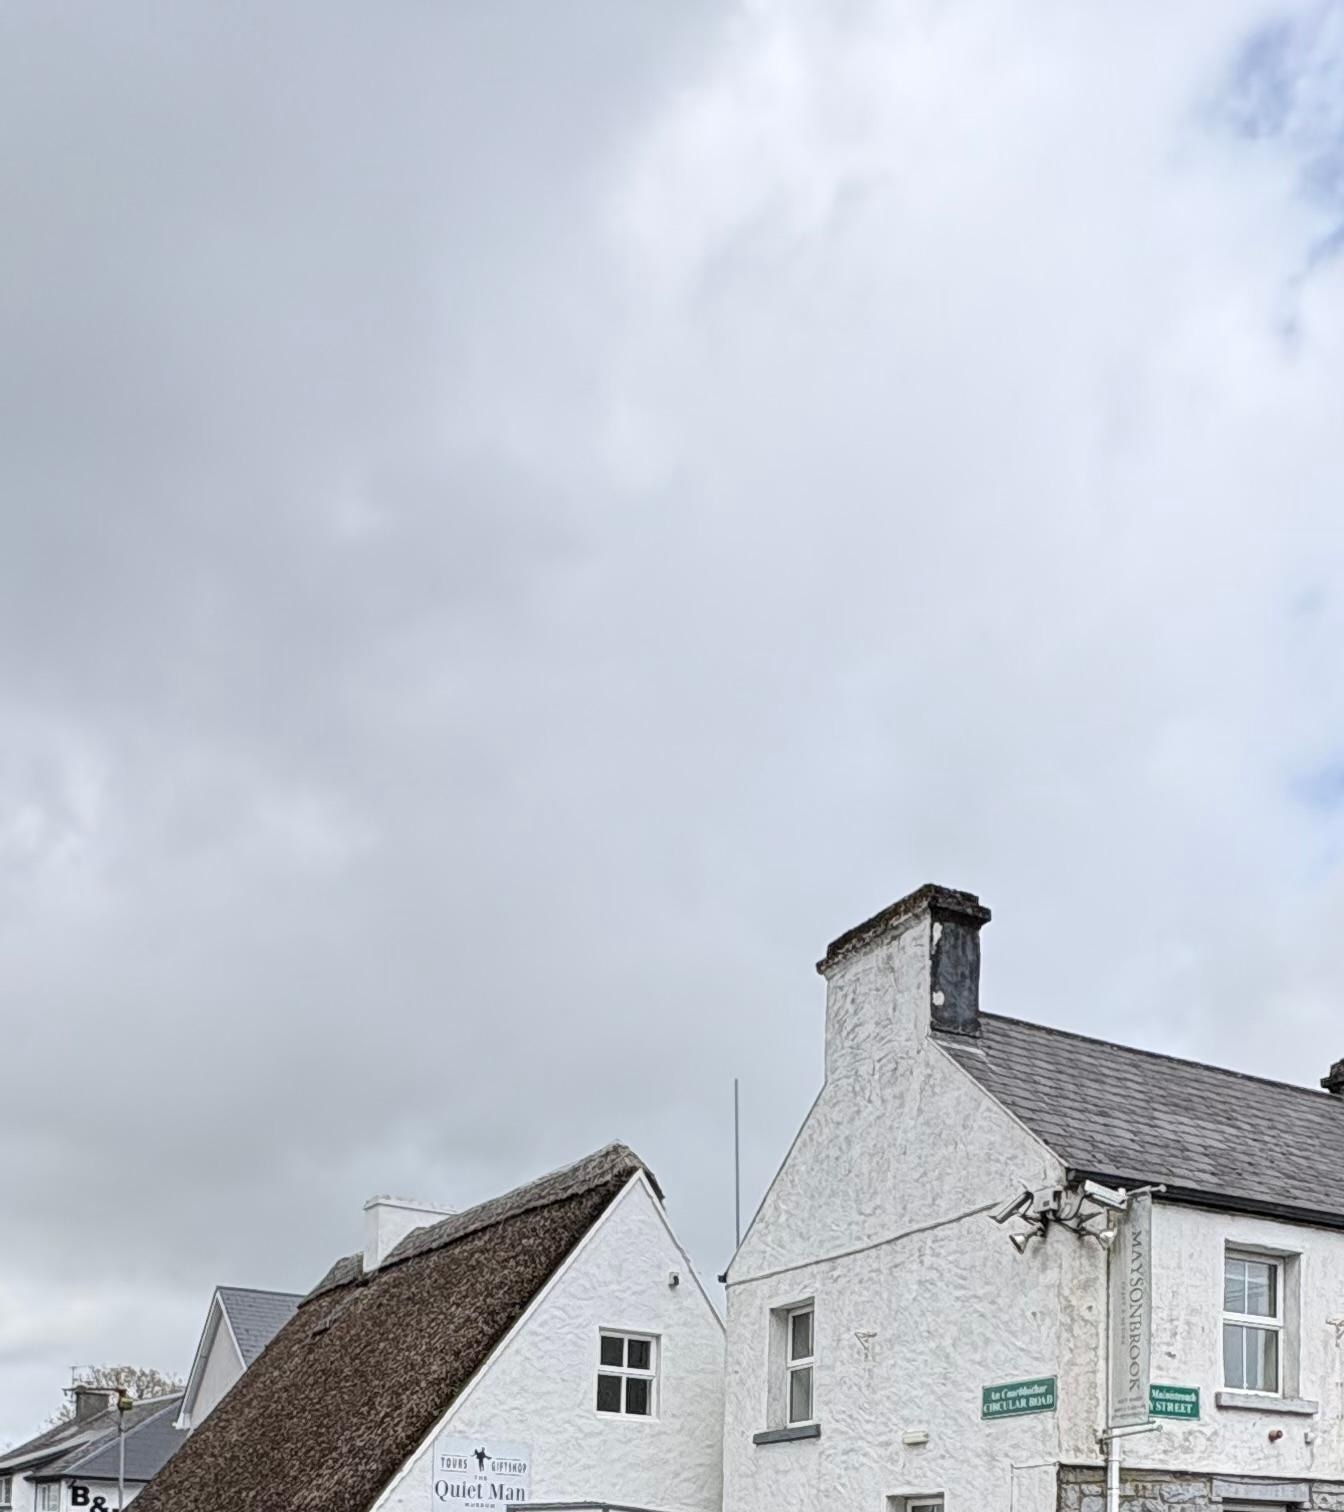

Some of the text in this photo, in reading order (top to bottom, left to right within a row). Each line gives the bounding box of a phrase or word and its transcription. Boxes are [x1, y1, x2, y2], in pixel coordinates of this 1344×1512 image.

[1129, 1229, 1145, 1393] MAYSONBROOK
[984, 1394, 1053, 1414] CIRCULAR ROAD
[1156, 1401, 1193, 1414] STREET
[440, 1456, 527, 1474] TOURS GIFTSHOP
[435, 1479, 526, 1502] Quiet Man
